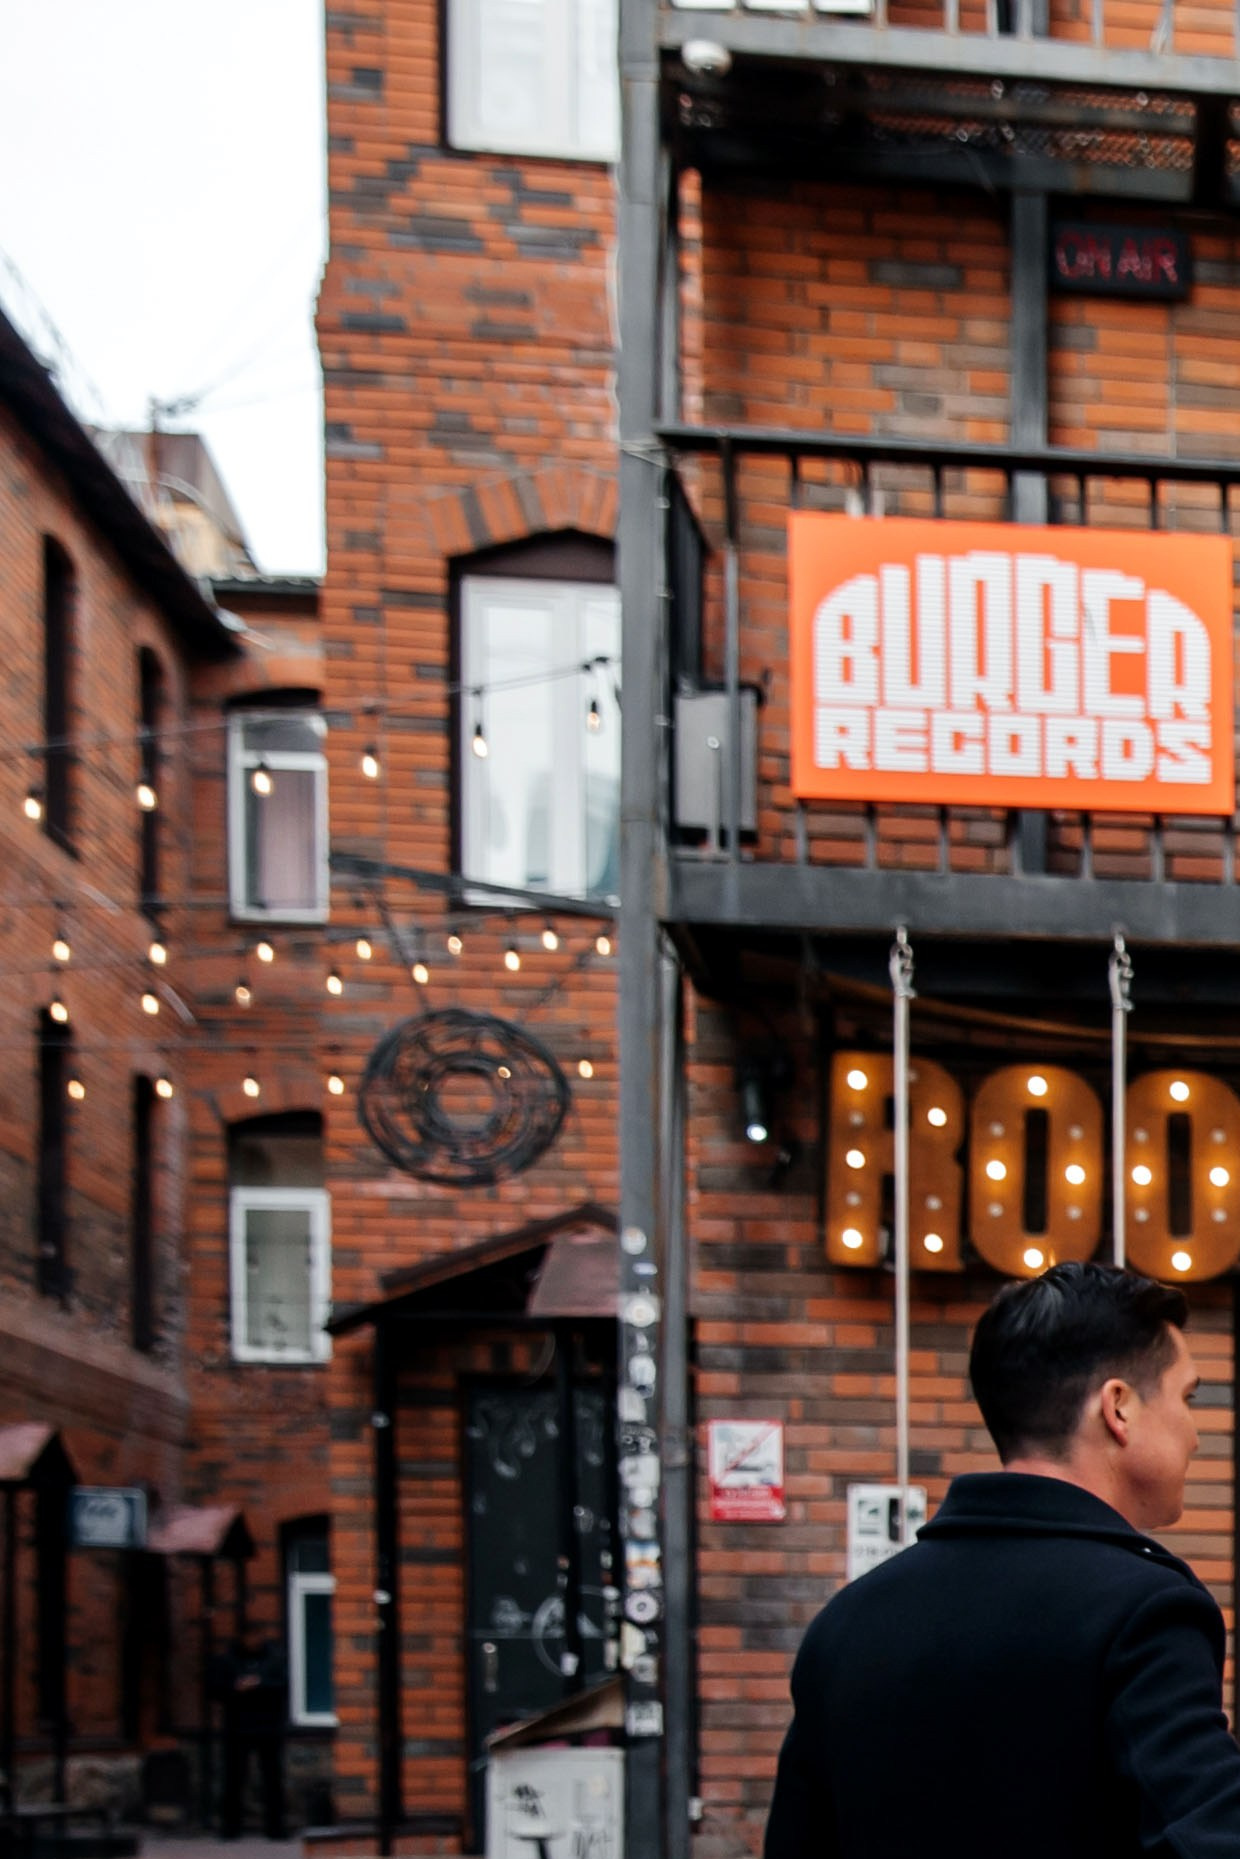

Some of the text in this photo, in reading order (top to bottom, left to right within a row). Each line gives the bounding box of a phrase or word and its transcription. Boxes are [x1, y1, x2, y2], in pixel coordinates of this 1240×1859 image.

[1055, 230, 1178, 286] ON AIR
[813, 550, 1213, 721] BURGER
[814, 706, 1213, 785] RECORDS
